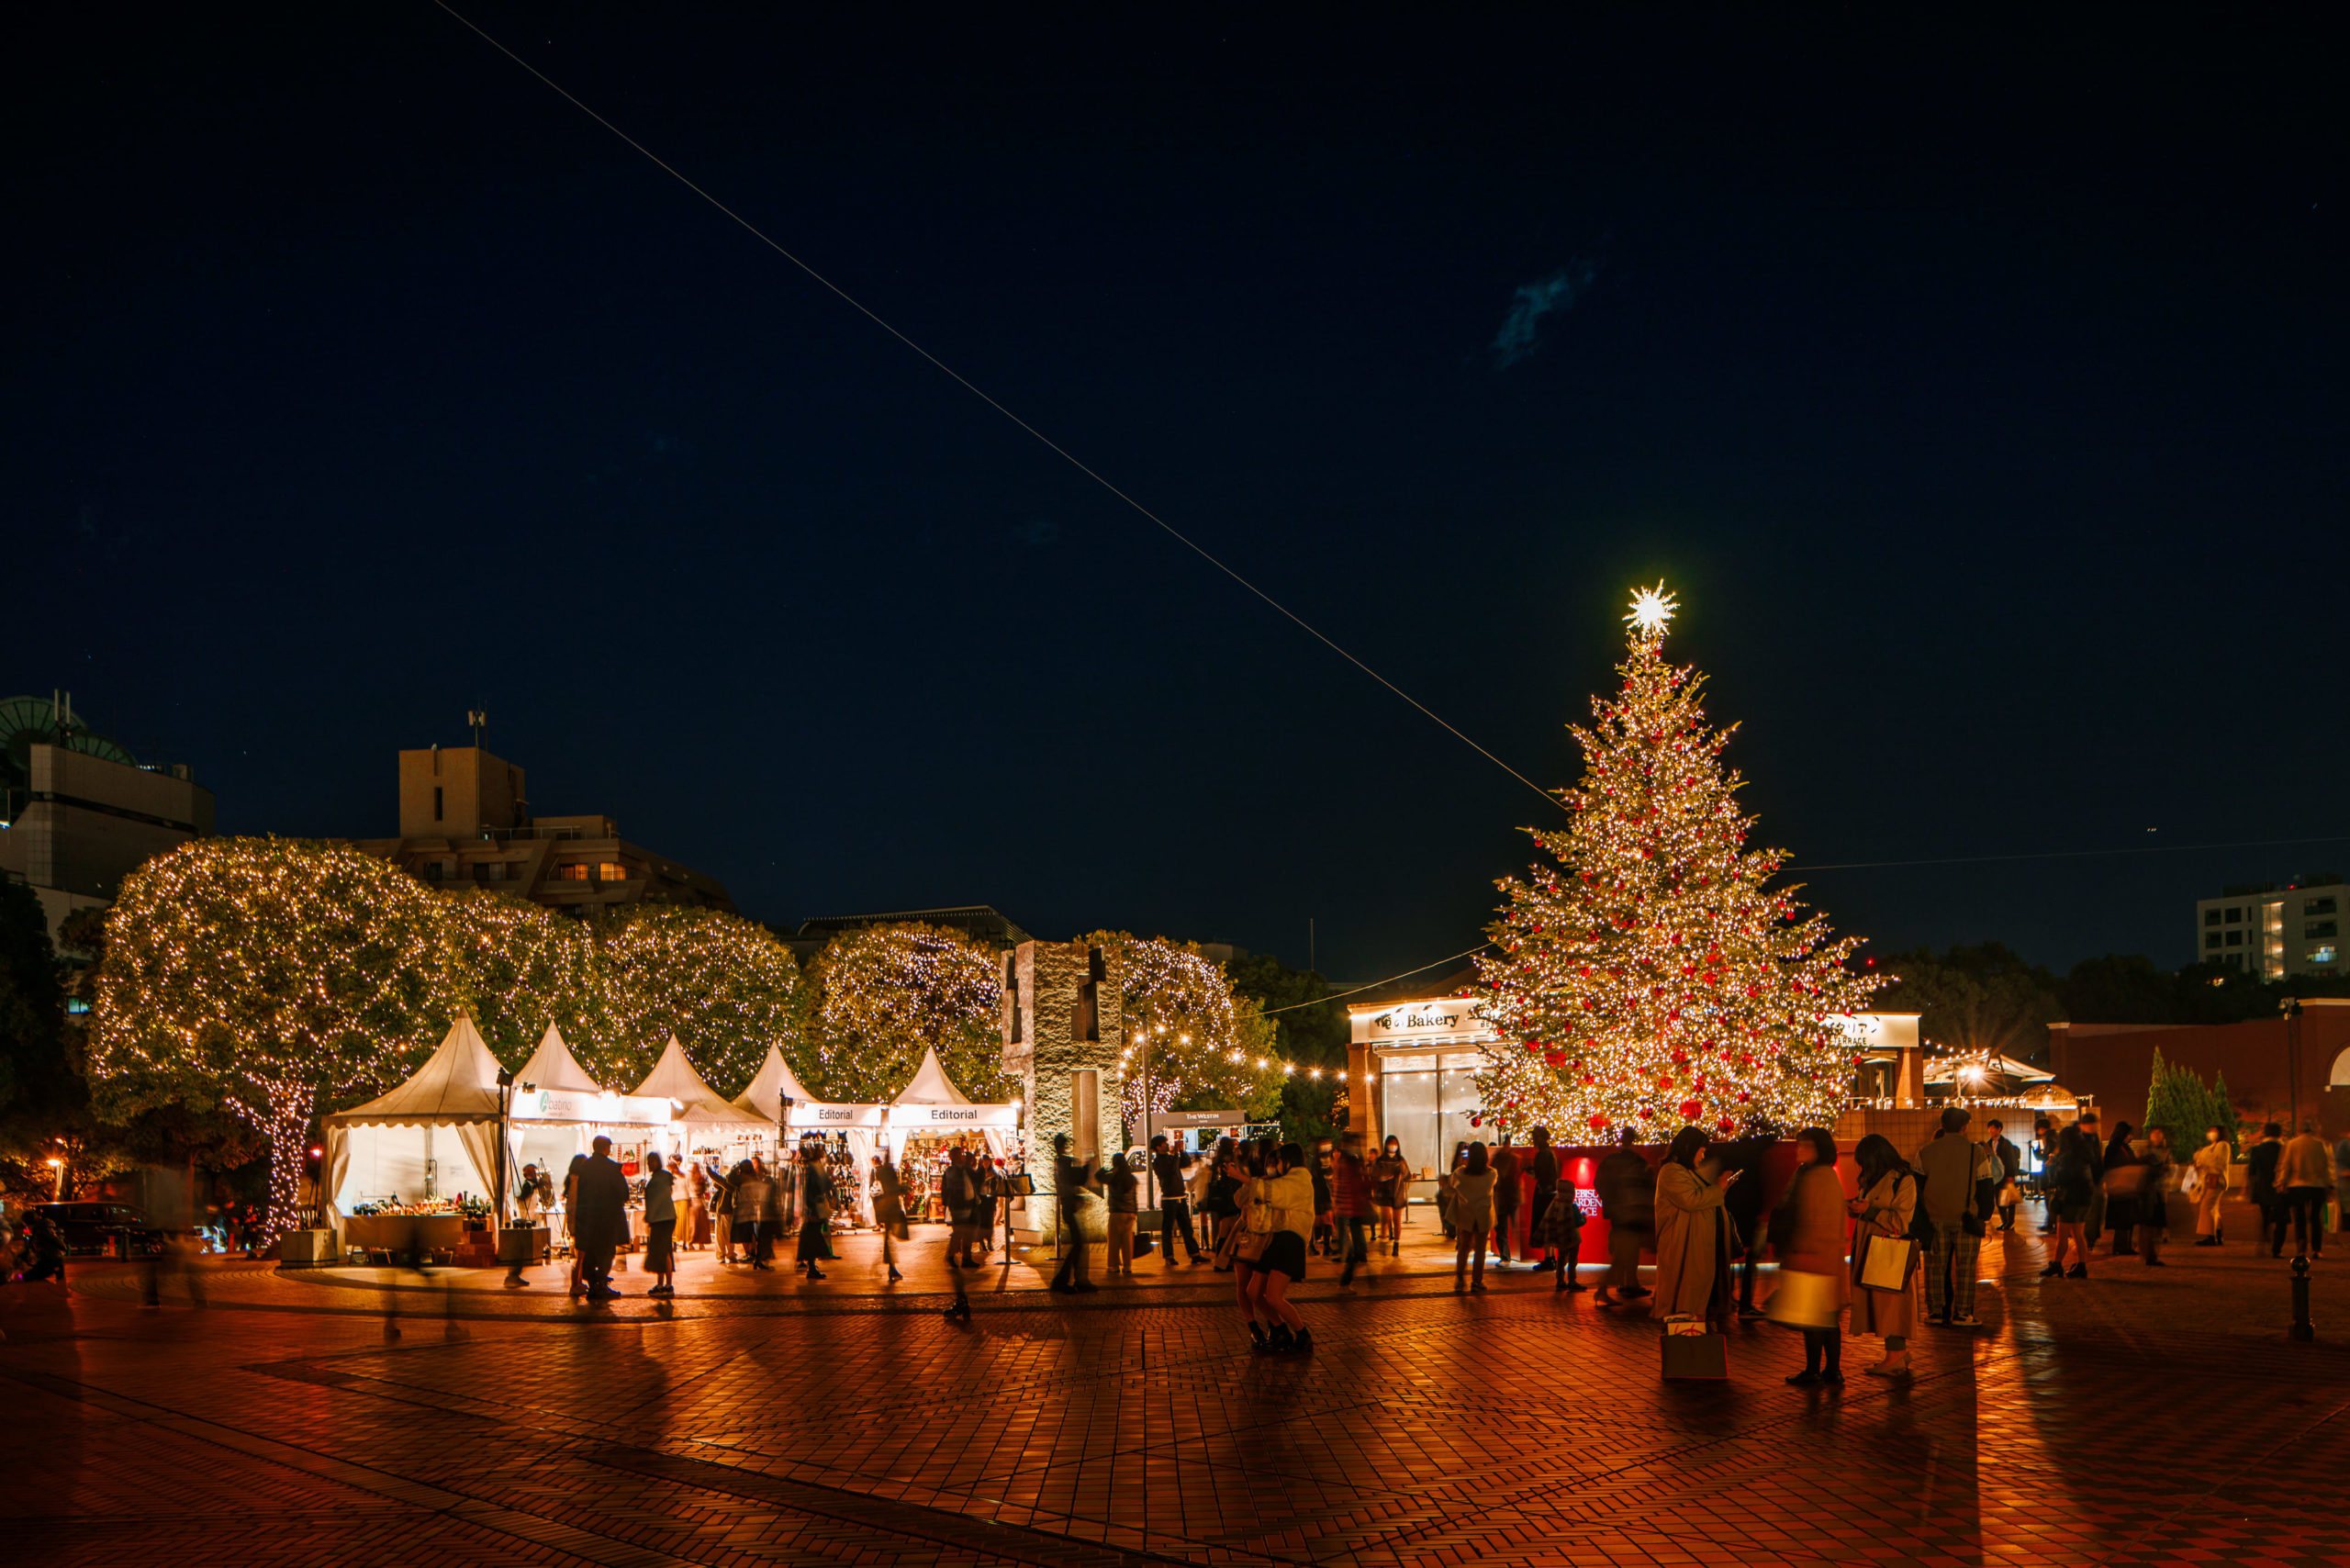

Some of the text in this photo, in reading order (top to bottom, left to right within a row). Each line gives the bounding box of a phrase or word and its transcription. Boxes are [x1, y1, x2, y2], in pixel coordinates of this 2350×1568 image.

[1407, 1014, 1460, 1027] Bakery
[819, 1109, 853, 1120] Editorial
[931, 1109, 978, 1120] Editorial
[1574, 1189, 1599, 1198] EBISU
[1573, 1198, 1603, 1207] ARDEN
[1580, 1207, 1597, 1216] ACE
